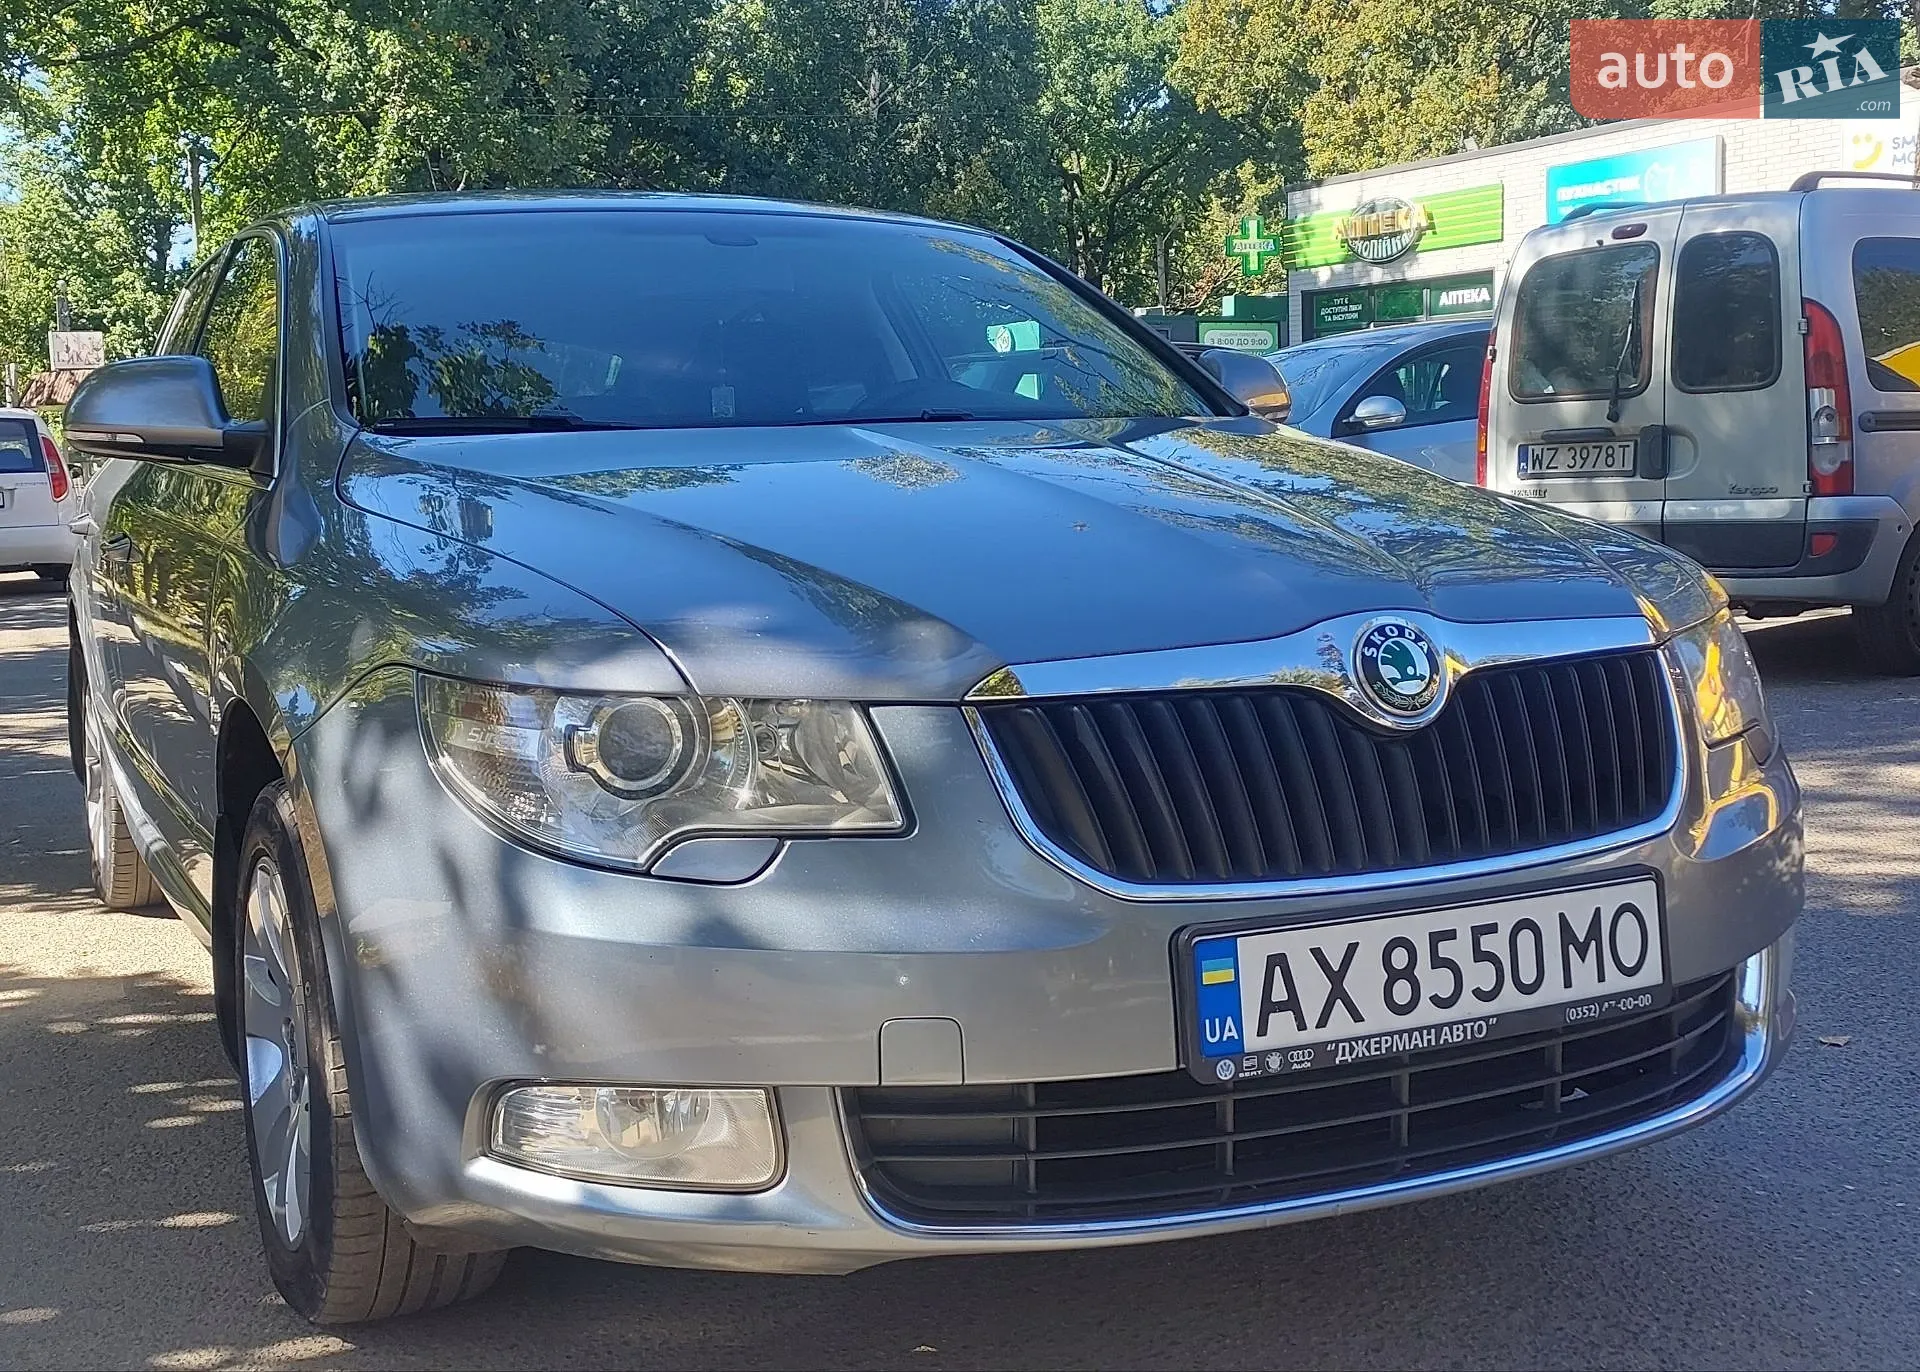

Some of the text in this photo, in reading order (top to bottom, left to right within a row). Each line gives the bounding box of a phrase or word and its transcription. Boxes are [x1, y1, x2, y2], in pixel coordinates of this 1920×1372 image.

[1333, 203, 1428, 240] АПТЕКА
[1233, 241, 1275, 251] АПТЕКА
[1438, 287, 1491, 307] АПТЕКА
[1217, 338, 1235, 346] 8:00
[1236, 338, 1249, 346] ДО
[1531, 444, 1631, 470] WZ 3978T
[1256, 902, 1648, 1038] AX 8550 MO
[1565, 1002, 1600, 1023] (0352)
[1205, 1016, 1239, 1043] UA
